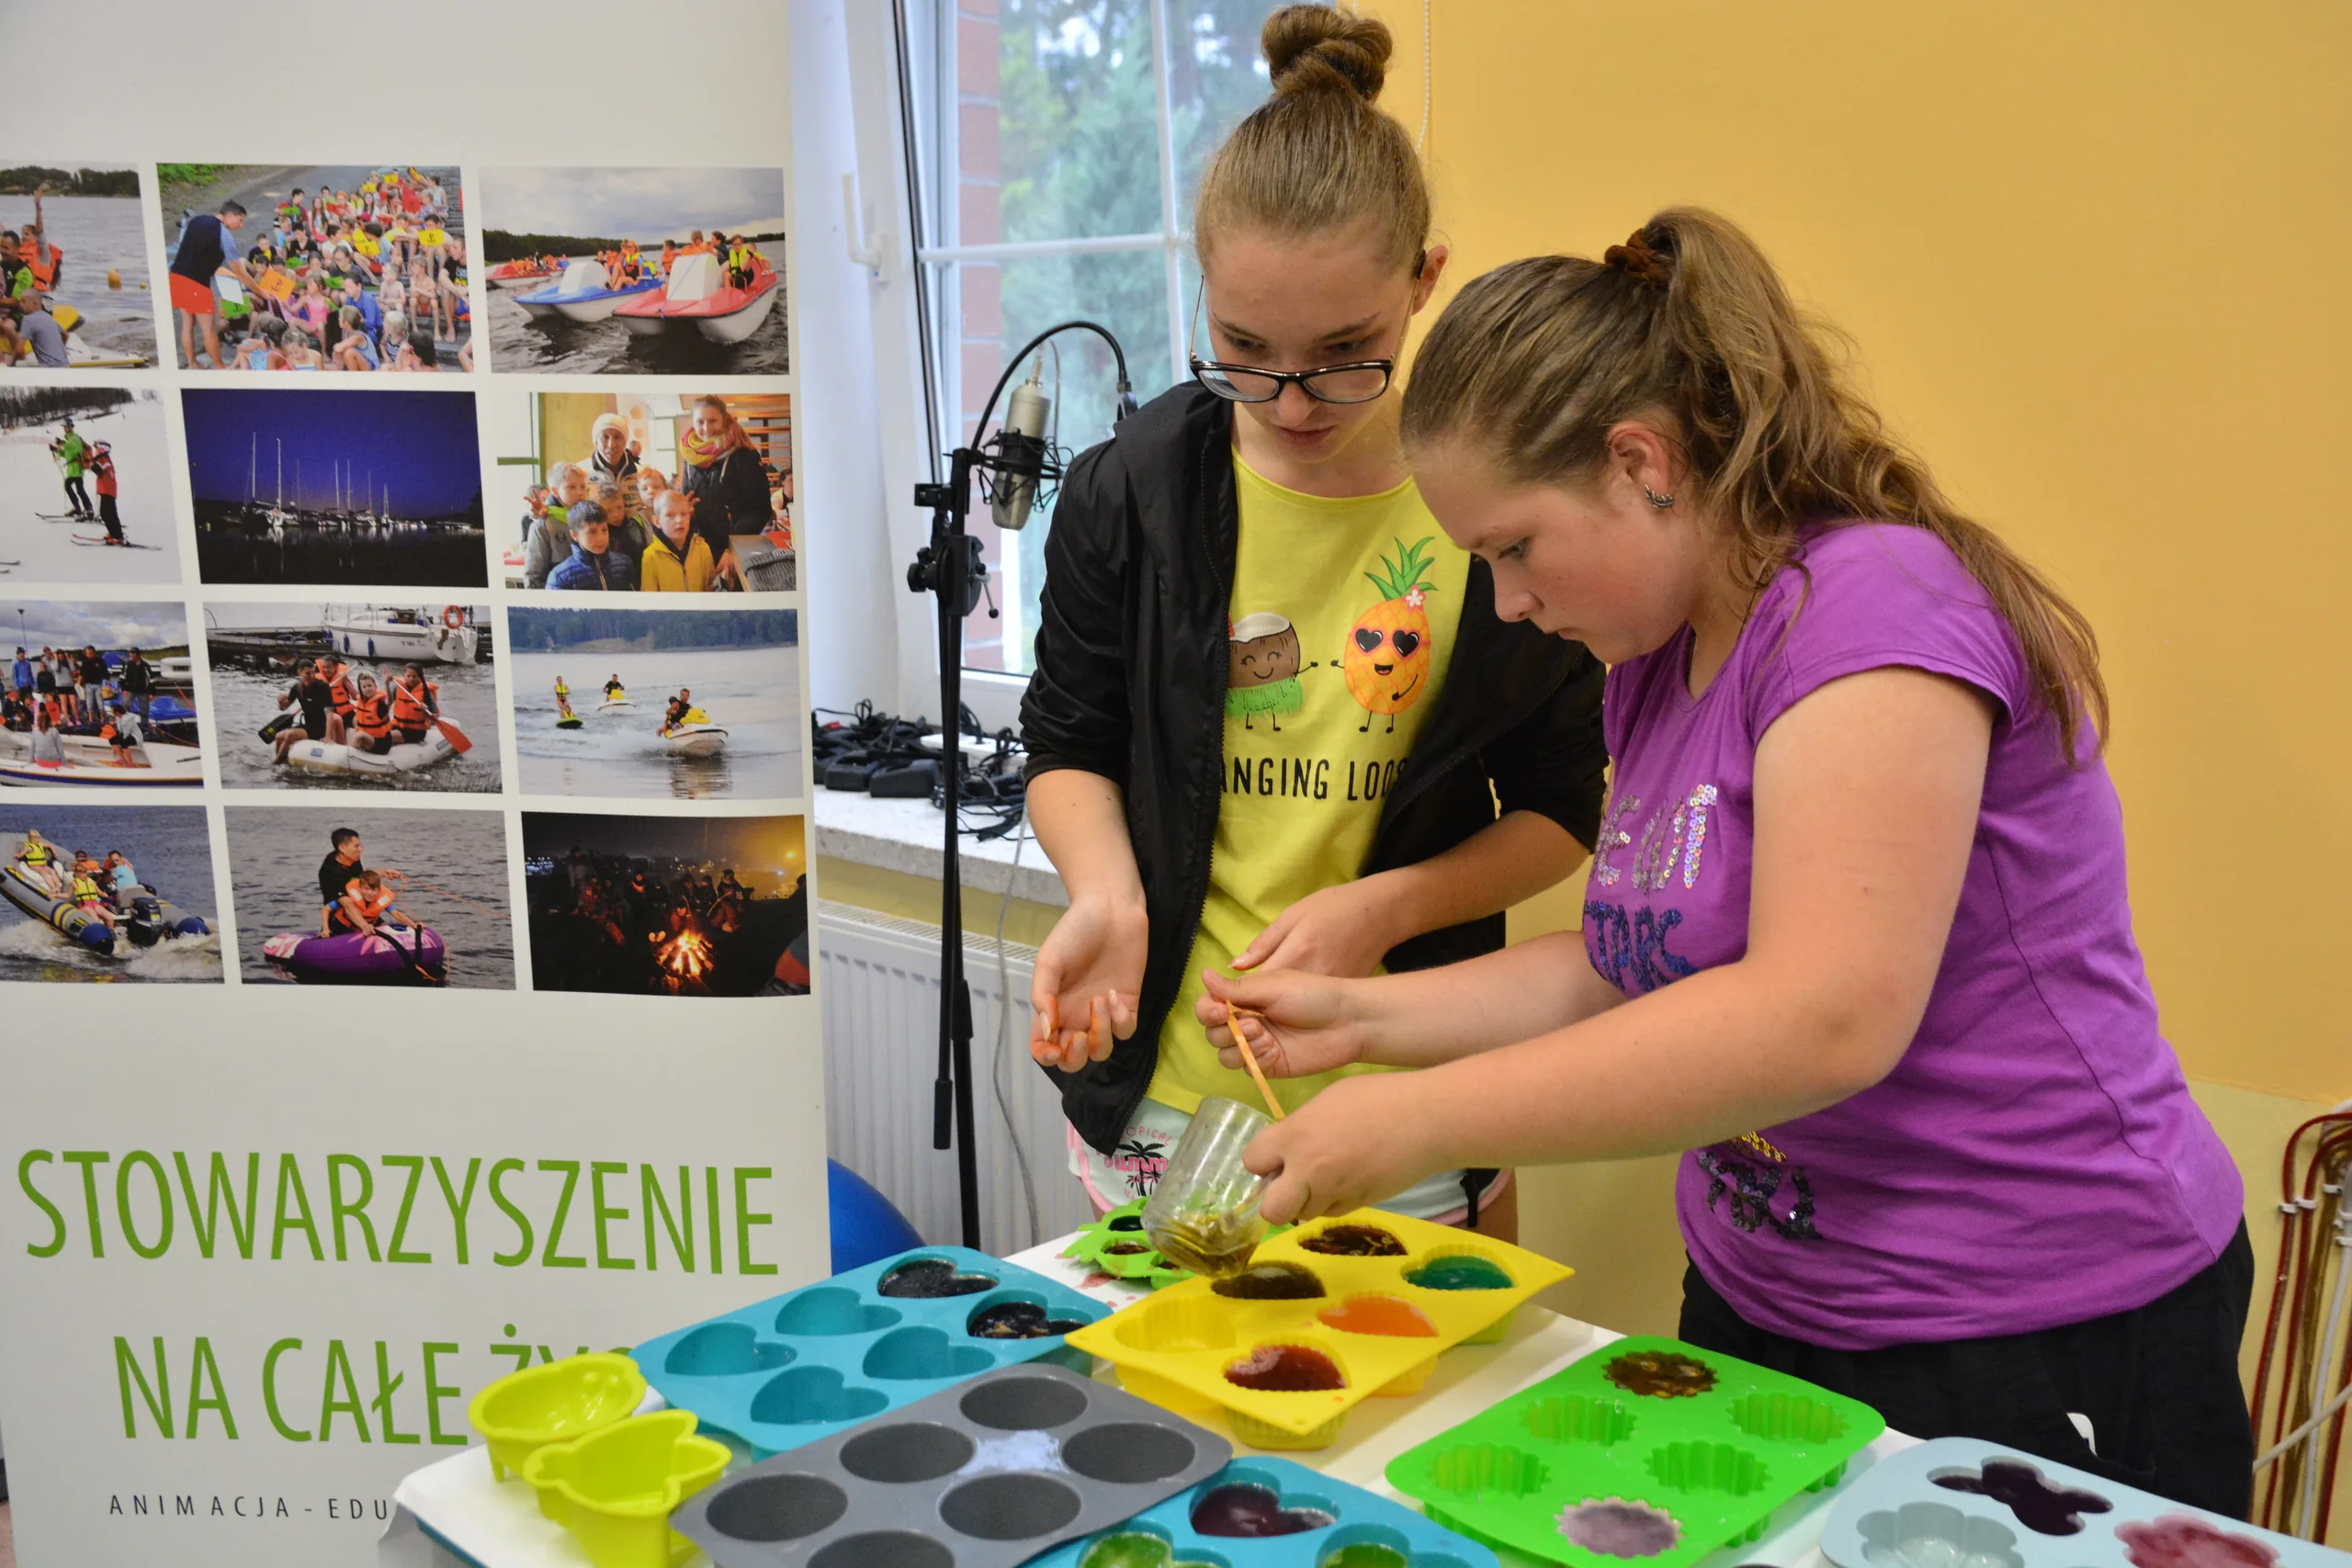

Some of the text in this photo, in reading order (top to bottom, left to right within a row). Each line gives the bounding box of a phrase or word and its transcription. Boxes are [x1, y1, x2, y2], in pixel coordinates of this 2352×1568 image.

[18, 1149, 779, 1276] STOWARZYSZENIE
[113, 1337, 239, 1439] NA
[262, 1337, 469, 1446] CAŁE
